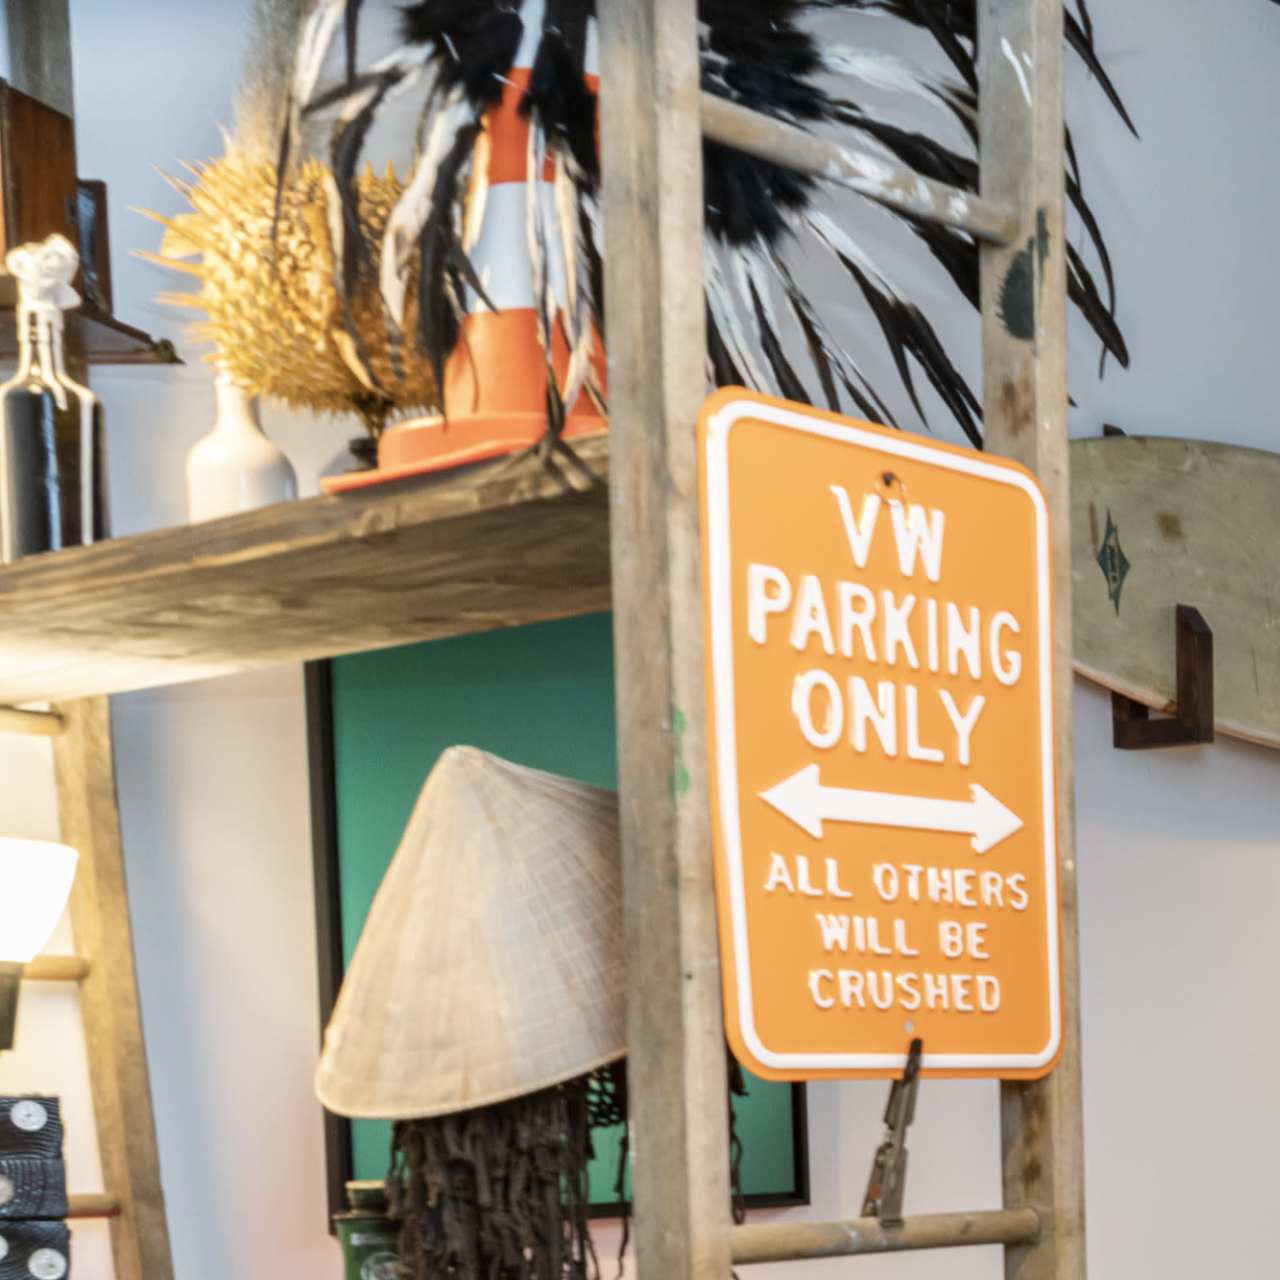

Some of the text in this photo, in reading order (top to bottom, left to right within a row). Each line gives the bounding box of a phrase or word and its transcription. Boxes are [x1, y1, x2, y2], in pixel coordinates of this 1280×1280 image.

[829, 483, 945, 583] VW
[746, 562, 1022, 686] PARKING
[791, 667, 986, 766] ONLY
[763, 852, 1029, 911] ALL OTHERS
[815, 912, 989, 959] WILL BE
[808, 968, 1001, 1012] CRUSHED
